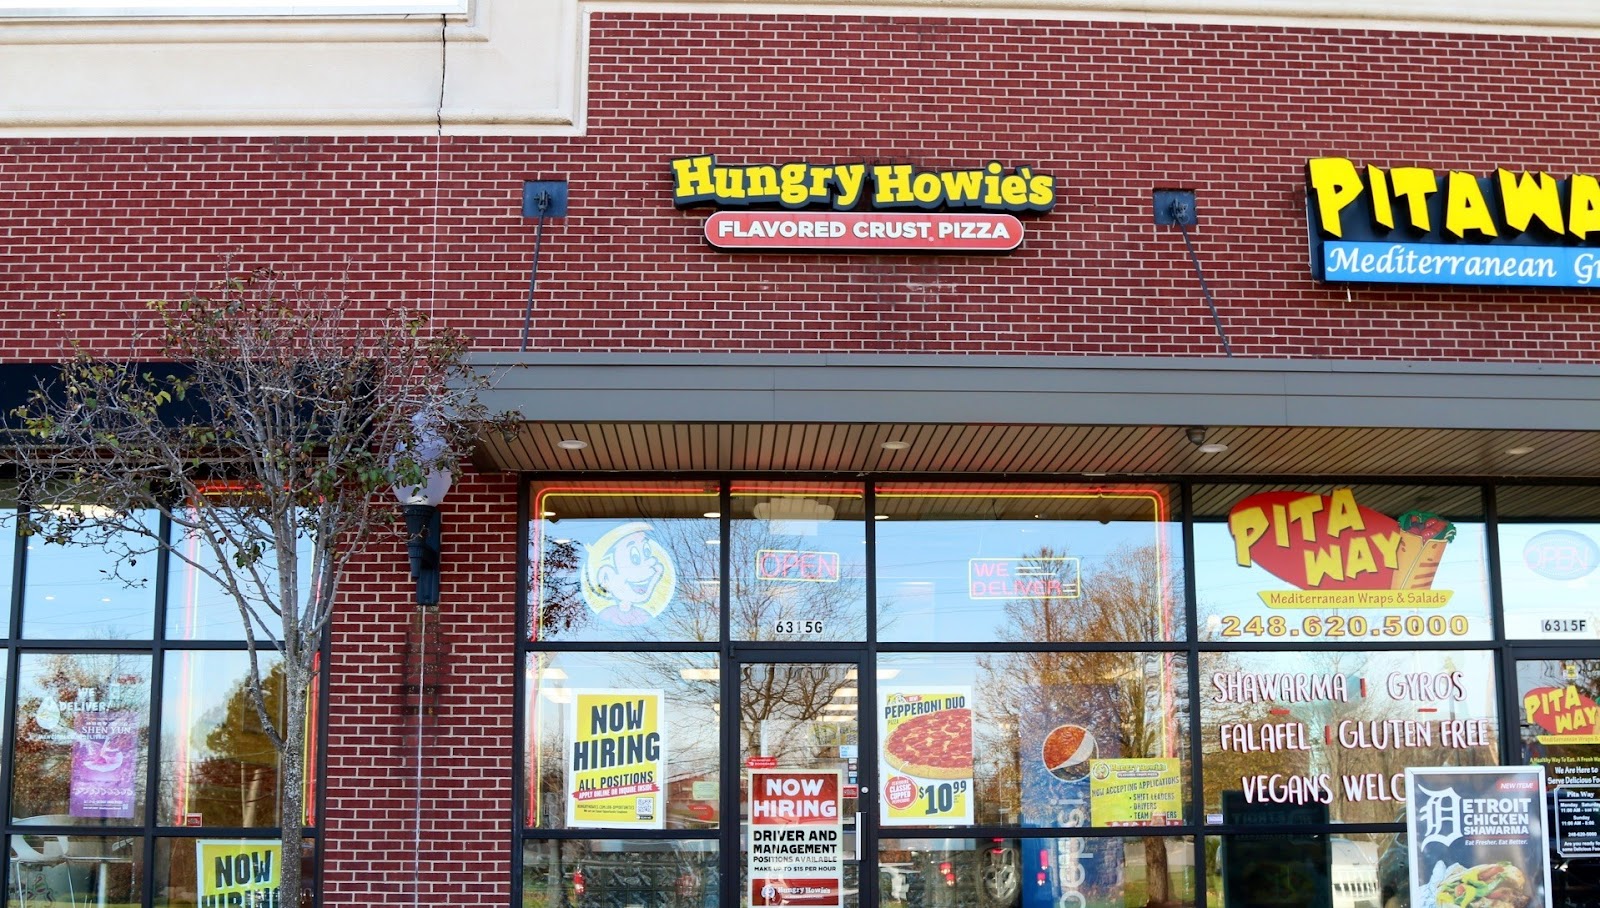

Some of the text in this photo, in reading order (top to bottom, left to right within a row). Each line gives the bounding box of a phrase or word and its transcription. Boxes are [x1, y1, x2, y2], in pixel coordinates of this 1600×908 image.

[672, 156, 1053, 205] Hungry Howie's
[719, 220, 1010, 240] FLAVORED CRUST PIZZA
[1327, 244, 1557, 278] Mediterranean
[1231, 488, 1365, 567] PITA
[760, 552, 836, 579] OPEN
[1304, 531, 1402, 587] WAY
[1524, 546, 1588, 569] OPEN
[973, 562, 1009, 577] WE
[972, 581, 1062, 596] DELIVER
[1270, 592, 1447, 607] Mediterranean Wraps & Salads
[776, 621, 823, 634] 6315G
[1221, 615, 1469, 637] 248.620.5000
[1544, 619, 1588, 632] 6315F
[1213, 671, 1467, 702] SHAWARMA GYROS
[885, 696, 966, 719] PEPPERONI DUO
[1524, 685, 1581, 724] PITA
[591, 699, 644, 735] NOW
[1554, 706, 1597, 734] WAY
[82, 726, 131, 734] SHEN YUN
[1220, 720, 1490, 753] FALAFEL GLUTEN FREE
[573, 732, 660, 771] HIRING
[1554, 766, 1564, 774] We
[1565, 766, 1575, 774] Are
[1576, 766, 1590, 774] Here
[578, 771, 653, 791] ALL POSITIONS
[766, 779, 824, 796] NOW
[889, 784, 911, 793] CLASSIC
[1092, 776, 1180, 798] NOW ACCEPTING APPLICATIONS
[1241, 773, 1406, 805] VEGANS WELC
[1547, 776, 1564, 785] Serve
[1565, 776, 1592, 784] Delicious
[578, 790, 593, 799] APPLY
[594, 788, 611, 797] ONLINE
[637, 783, 653, 792] INSIDE
[890, 790, 911, 800] CUPPED
[1133, 793, 1175, 801] SHIFT LEADERS
[1580, 791, 1595, 799] Way
[753, 800, 837, 817] HIRING
[1463, 813, 1529, 826] CHICKEN
[753, 830, 837, 842] DRIVER AND
[1463, 825, 1529, 836] SHAWARMA
[753, 844, 837, 854] MANAGEMENT
[215, 850, 271, 888] NOW
[202, 886, 281, 908] RIN
